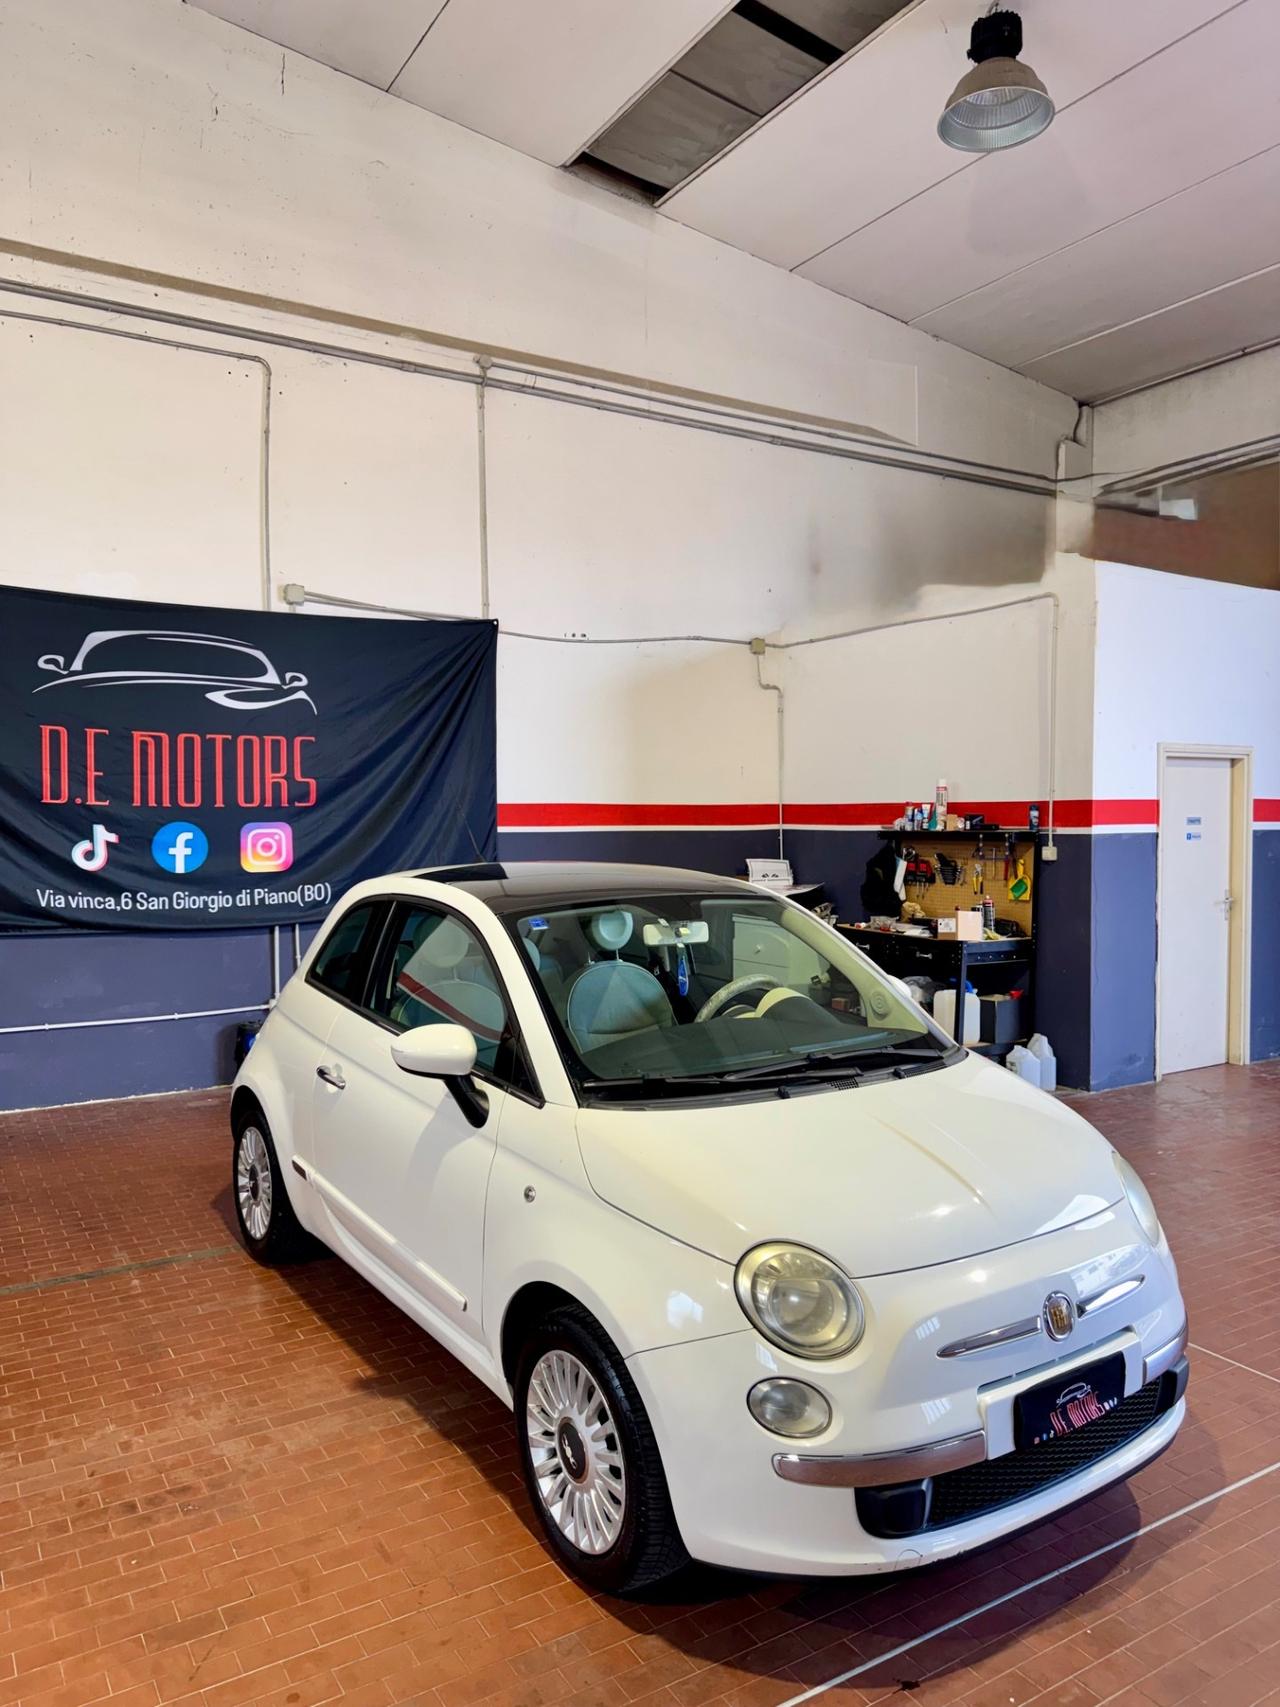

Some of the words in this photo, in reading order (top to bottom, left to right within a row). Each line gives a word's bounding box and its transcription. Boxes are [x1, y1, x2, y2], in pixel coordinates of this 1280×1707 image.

[40, 725, 110, 806] D.E
[131, 731, 317, 808] MOTORS
[36, 888, 66, 908] Via
[68, 891, 132, 912] vinca,6
[136, 891, 169, 910] San
[172, 890, 232, 913] Giorgio
[236, 889, 250, 907] di
[254, 882, 332, 907] Piano(BO)
